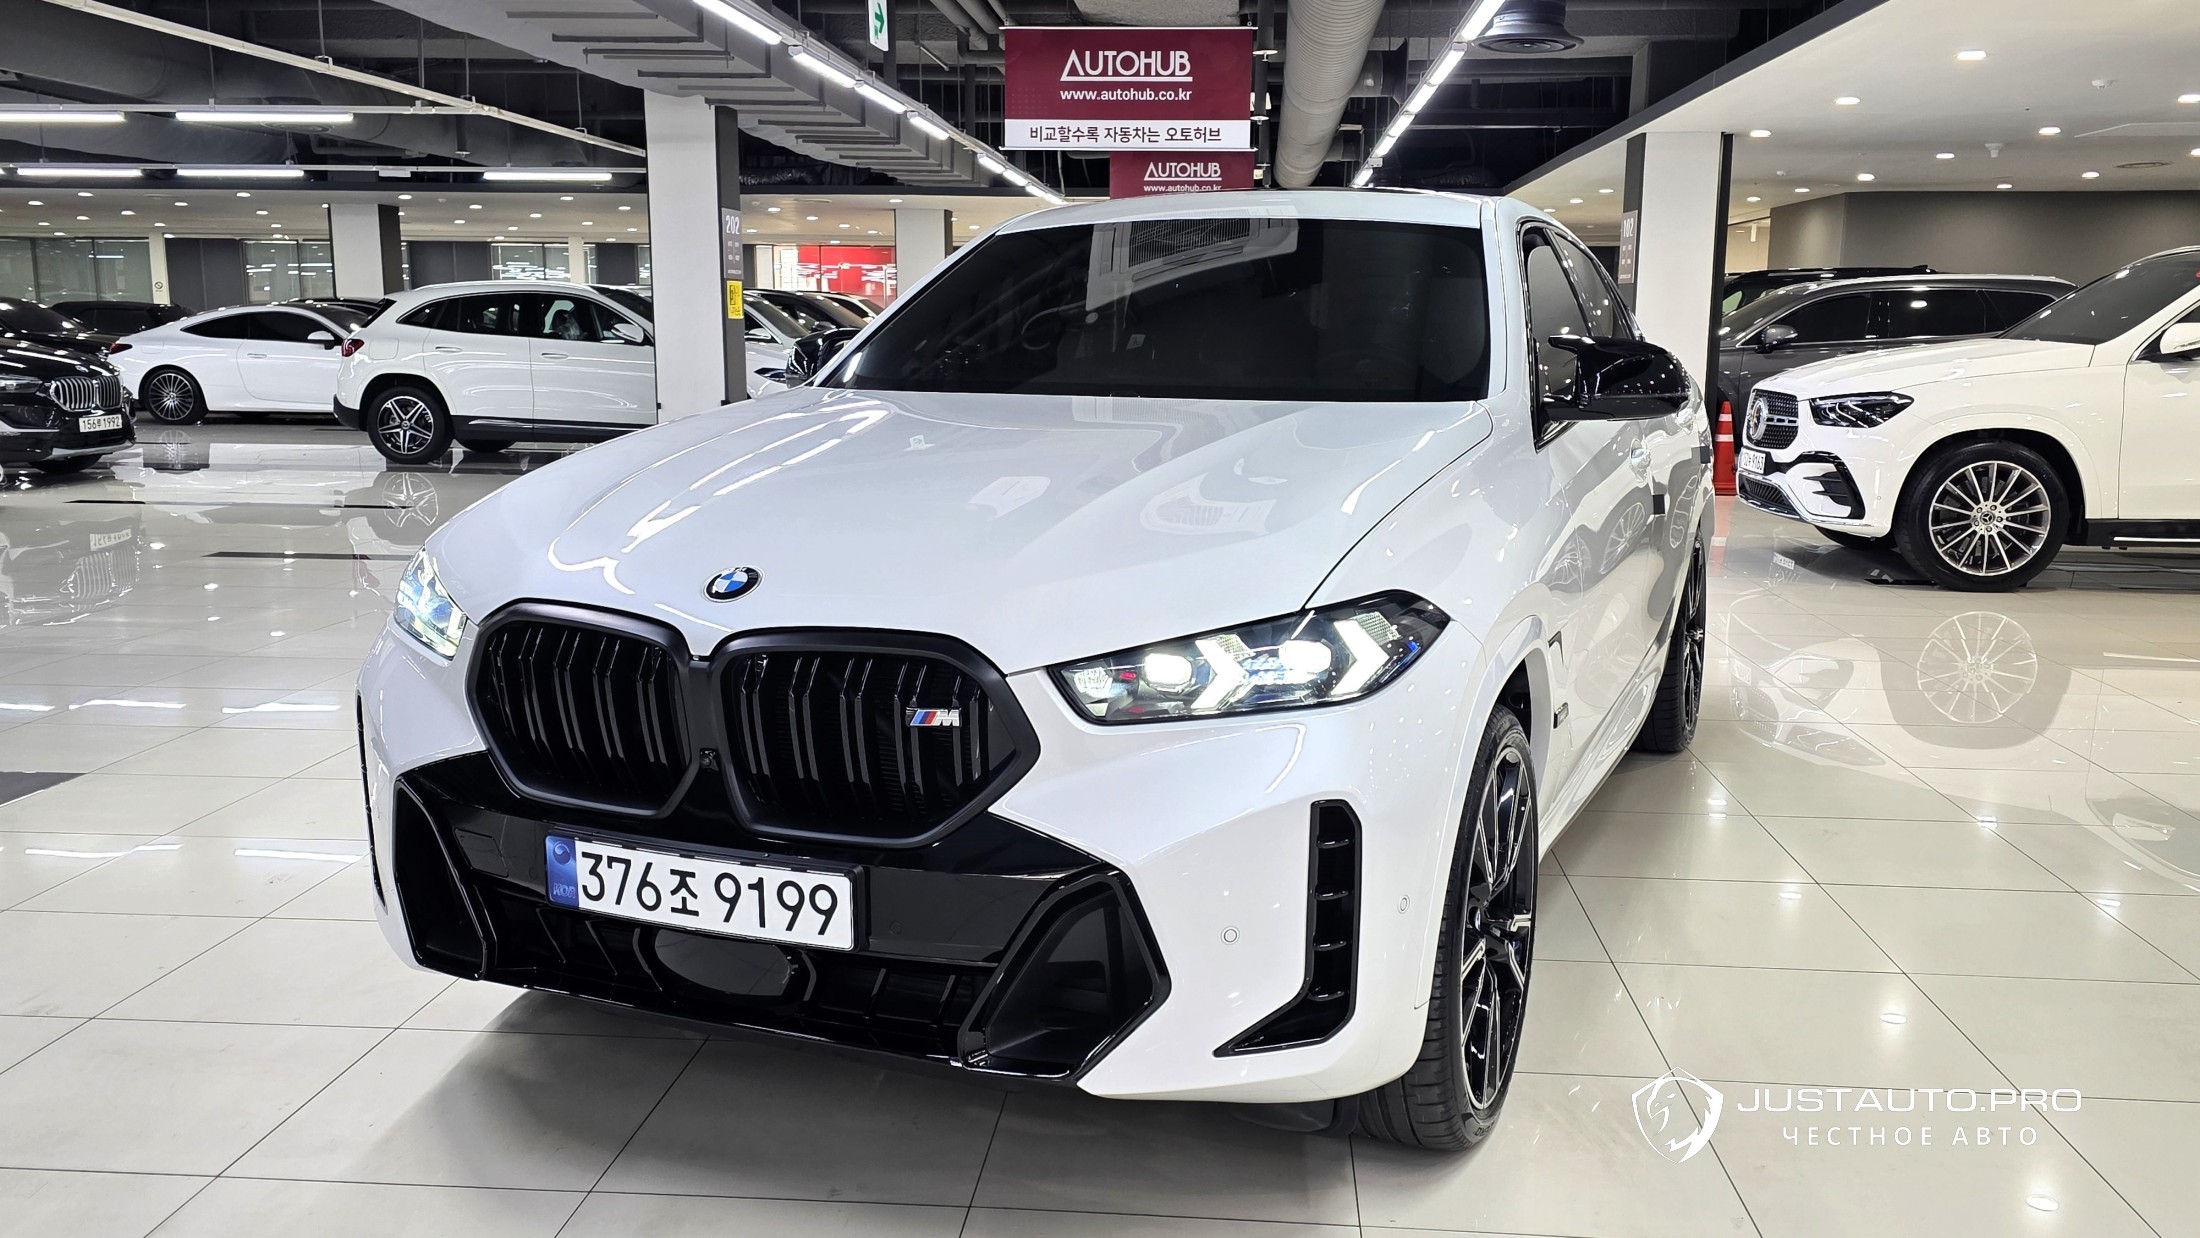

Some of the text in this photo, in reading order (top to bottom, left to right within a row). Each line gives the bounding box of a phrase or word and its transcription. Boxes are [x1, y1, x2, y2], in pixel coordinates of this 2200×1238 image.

[1060, 49, 1193, 82] AUTOHUB
[1060, 88, 1192, 101] www.autohub.co.kr
[1030, 126, 1222, 143] 비교할수록 자동차는 오토허브
[1143, 161, 1222, 181] AUTOHUB
[1143, 184, 1222, 192] www.autohub.cokr
[726, 215, 740, 234] 202
[1623, 217, 1634, 238] 102
[553, 883, 577, 899] KOR
[581, 851, 838, 936] 376조 9199
